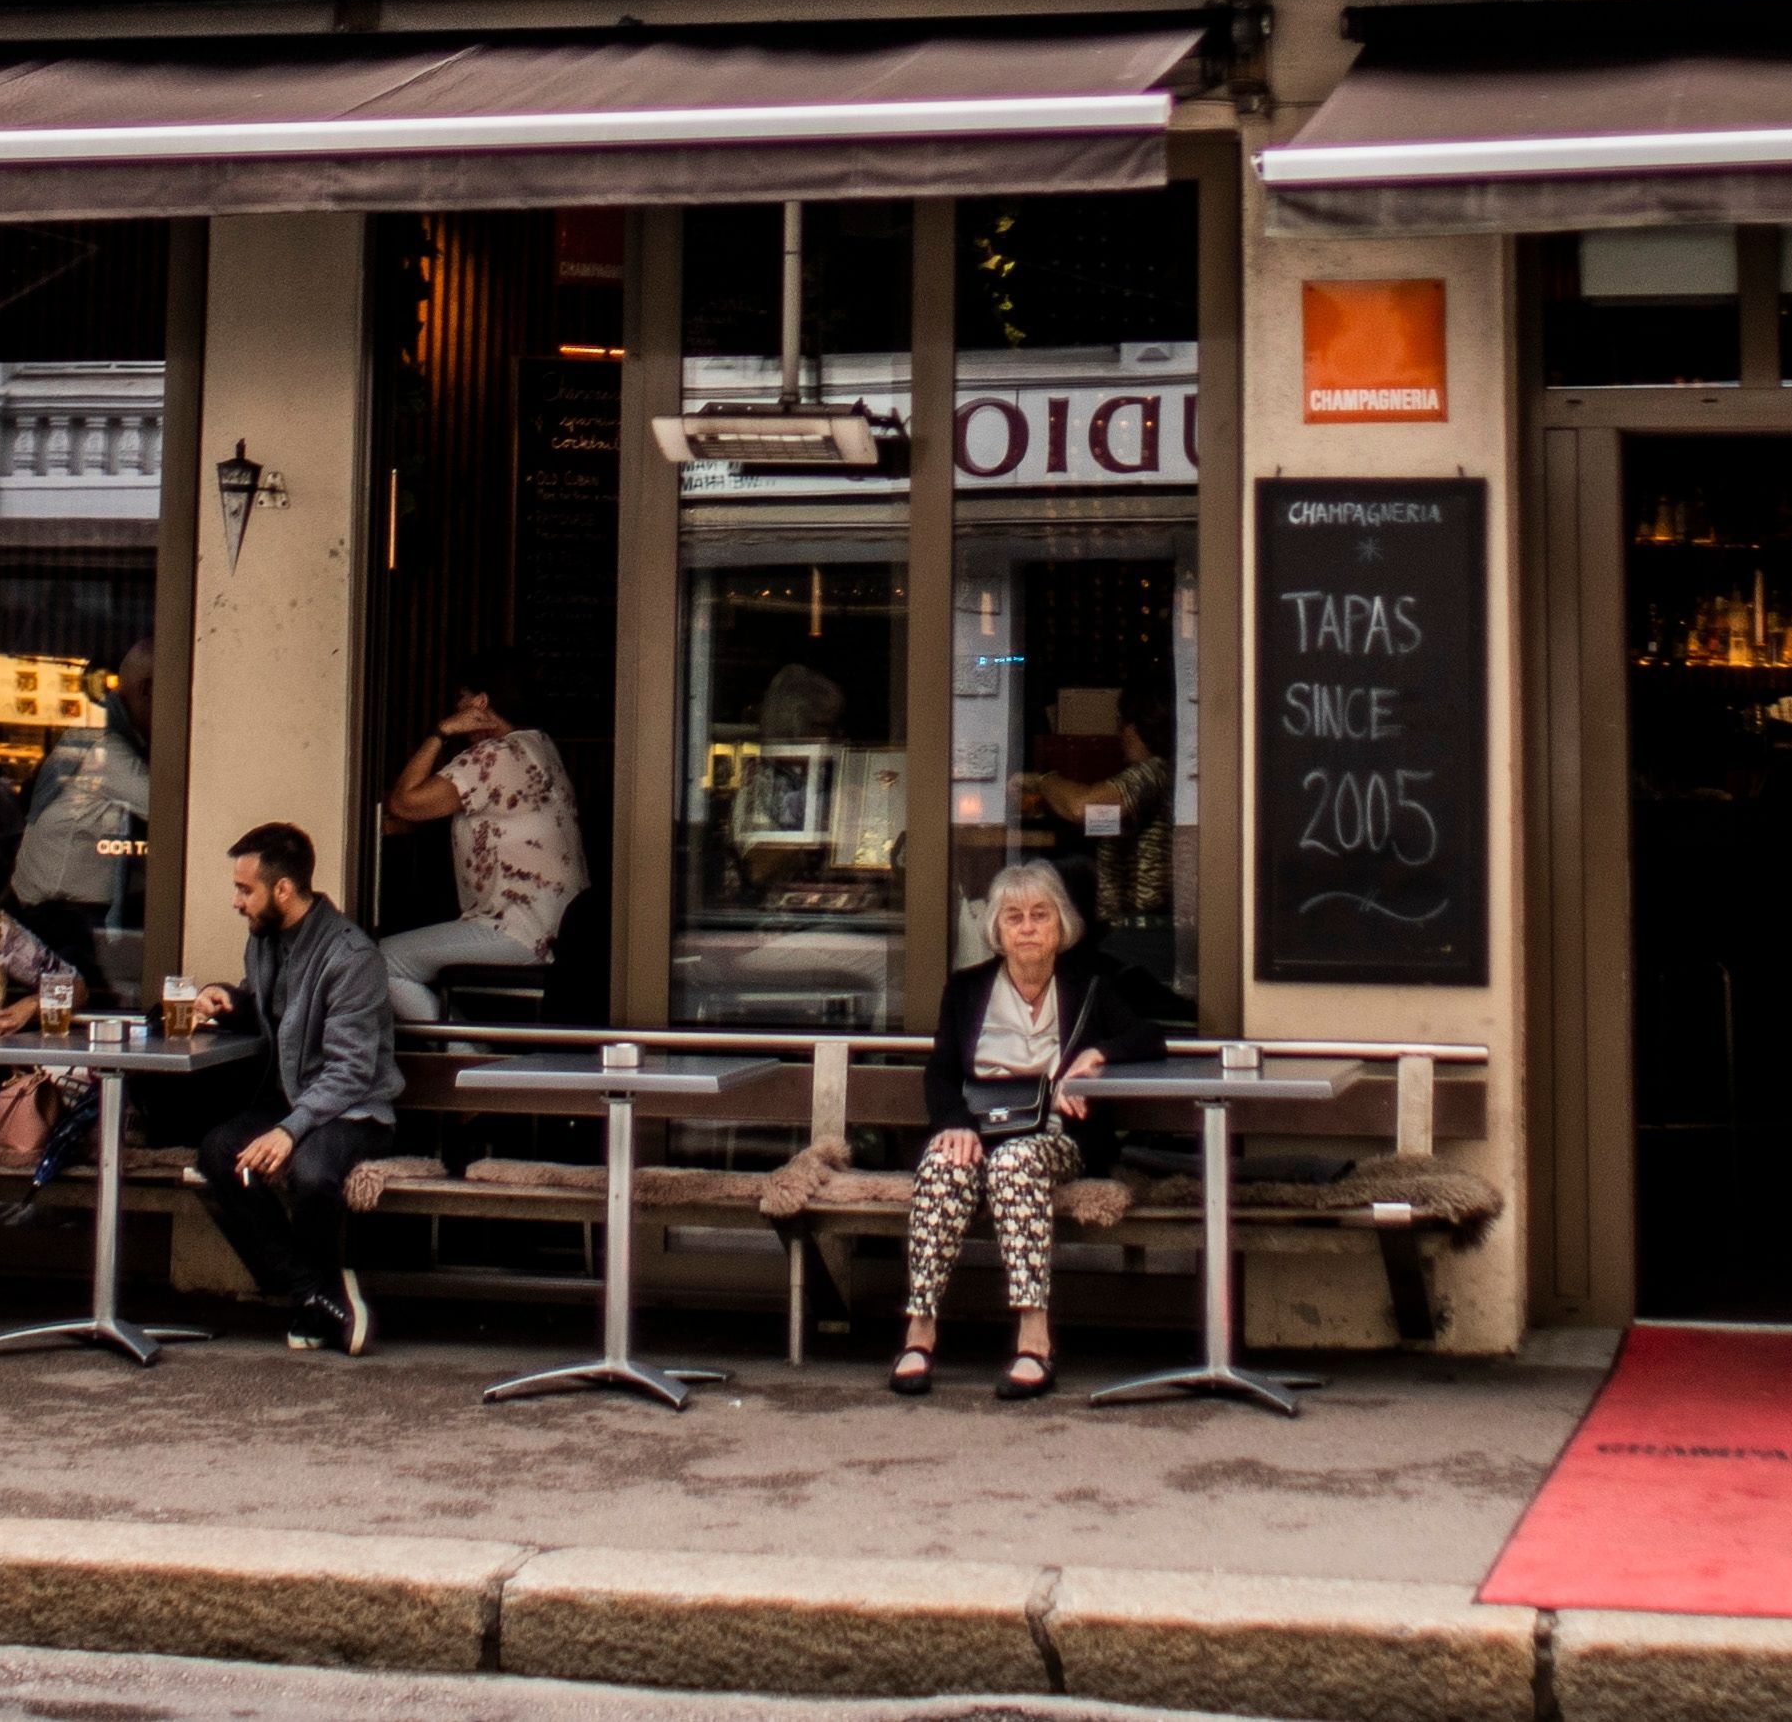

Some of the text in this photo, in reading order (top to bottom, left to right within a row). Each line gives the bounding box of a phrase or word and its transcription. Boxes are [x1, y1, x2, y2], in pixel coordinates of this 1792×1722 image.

[1309, 388, 1439, 412] CHAMPAGNERIA
[1288, 500, 1443, 526] CHAMPAGNERIA
[1280, 590, 1422, 655] TAPAS
[1282, 681, 1403, 741] SINCE
[1298, 767, 1437, 868] 2005
